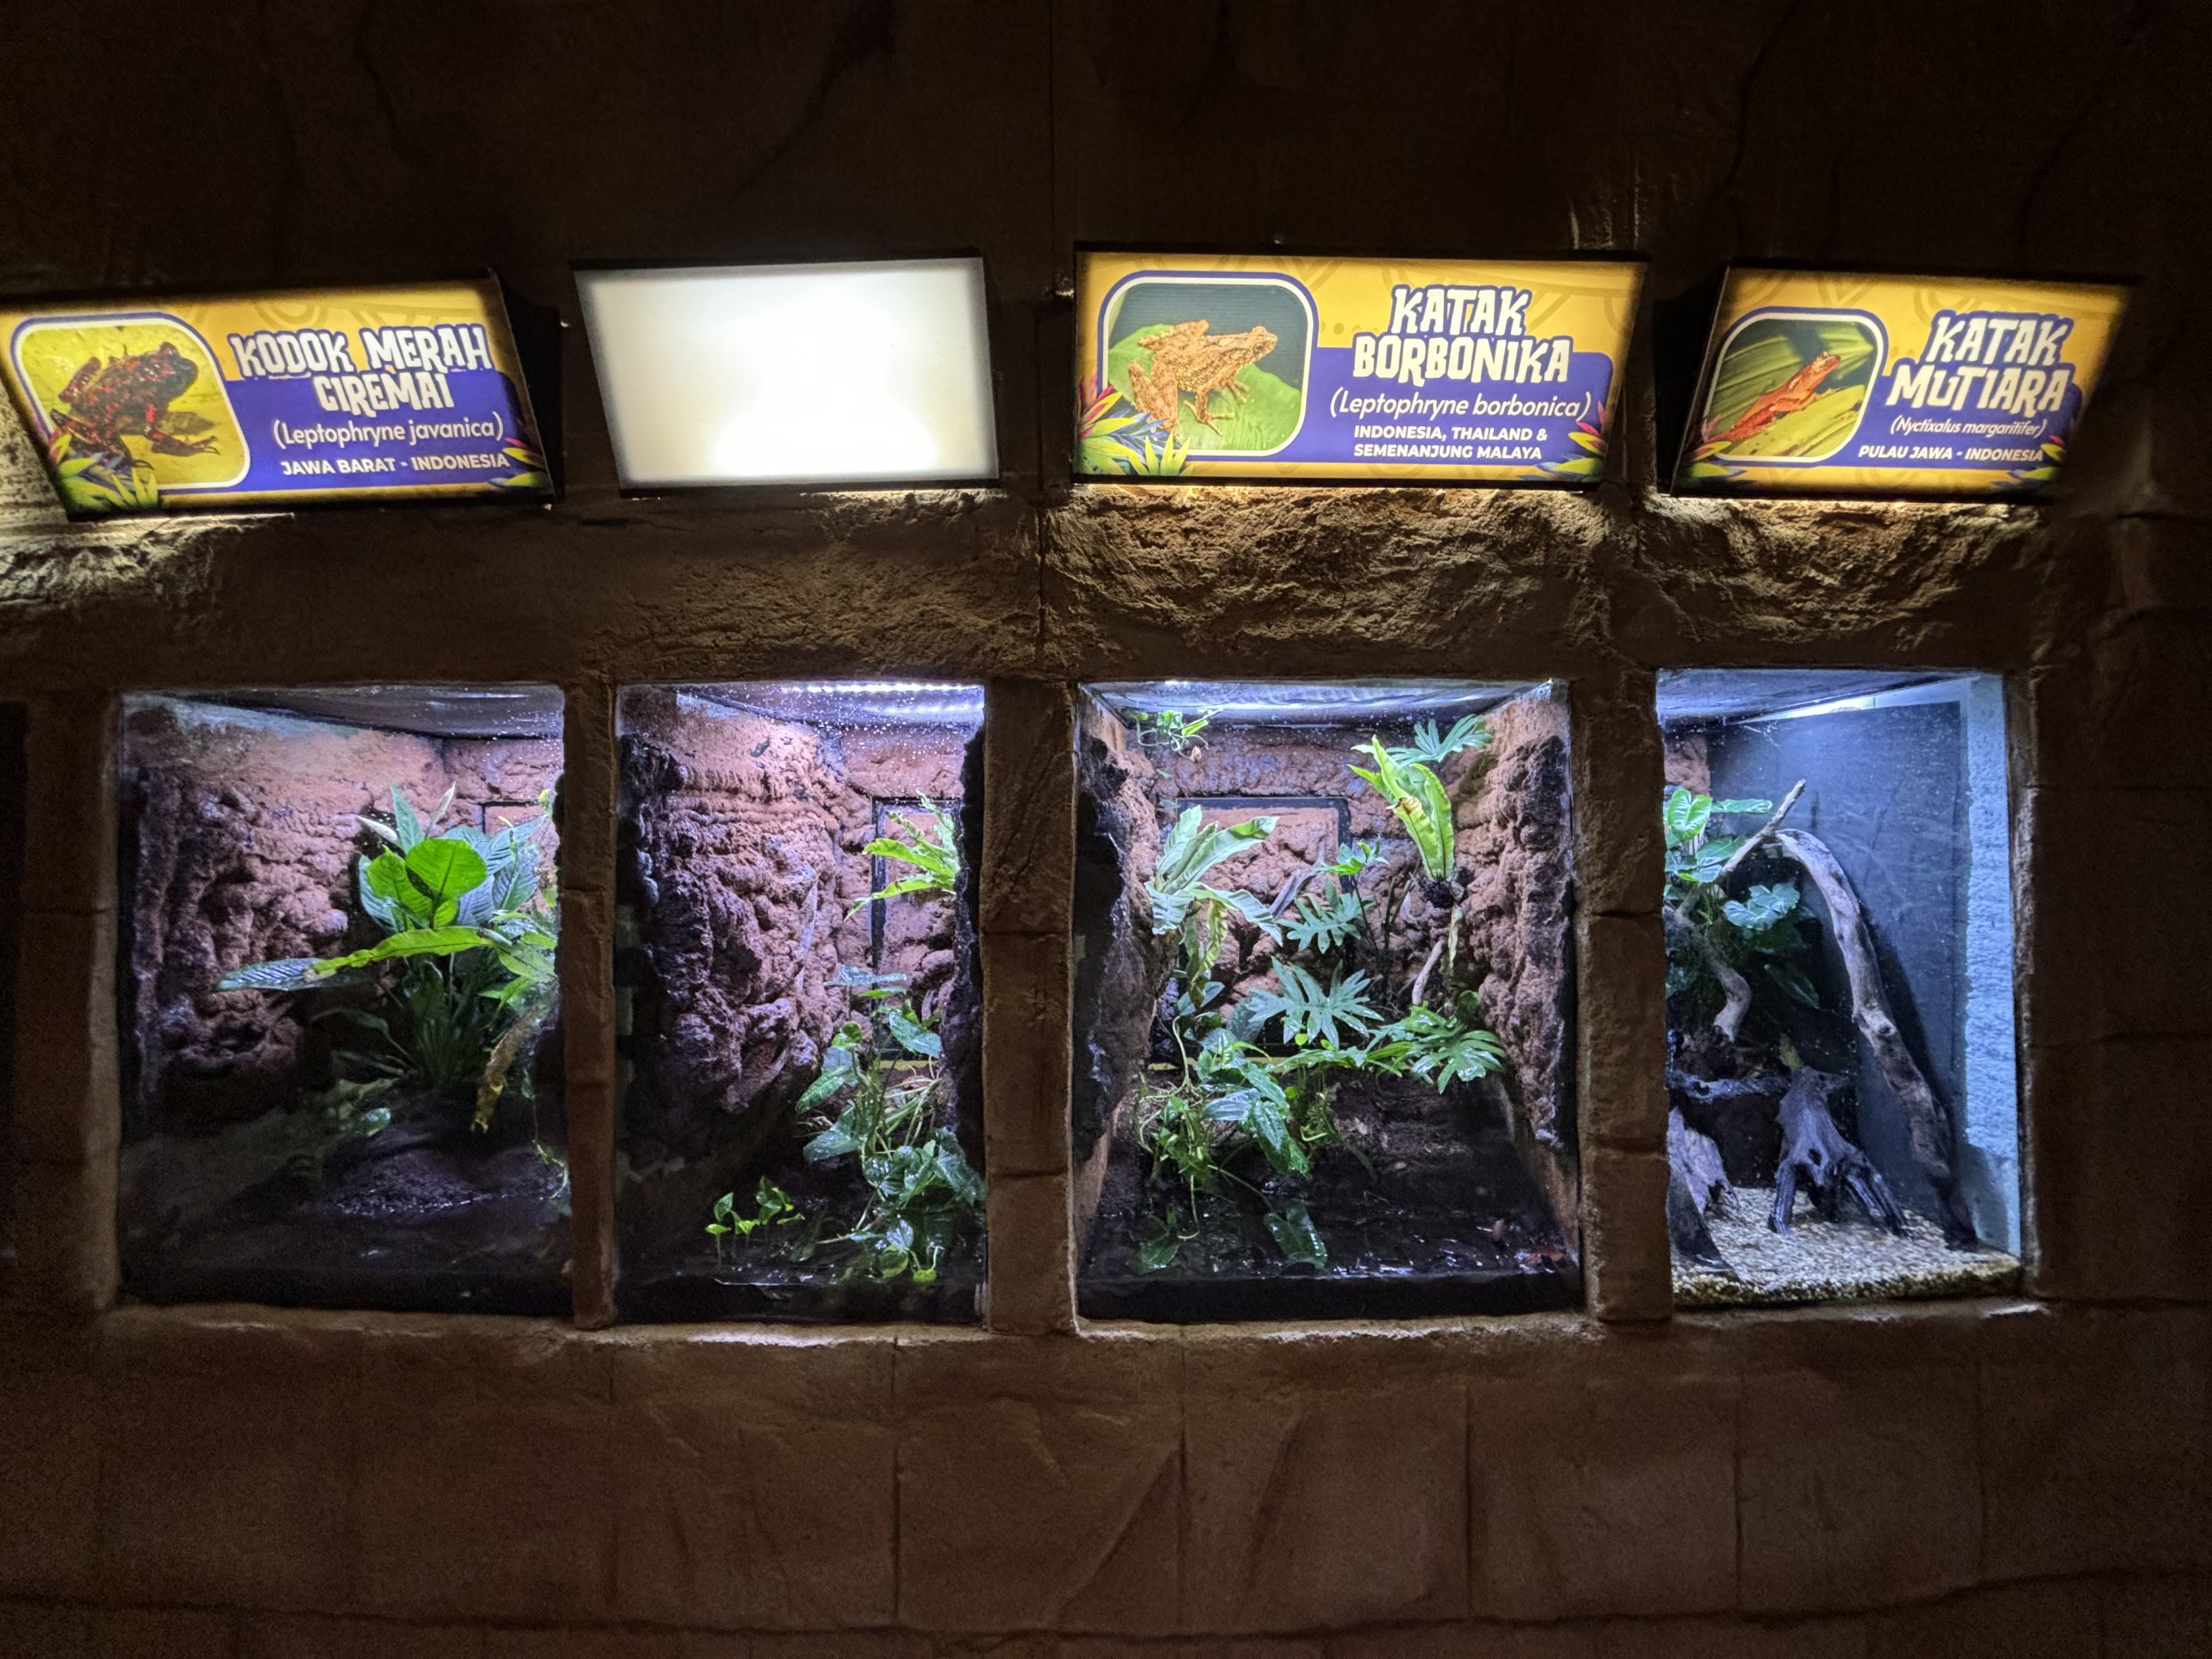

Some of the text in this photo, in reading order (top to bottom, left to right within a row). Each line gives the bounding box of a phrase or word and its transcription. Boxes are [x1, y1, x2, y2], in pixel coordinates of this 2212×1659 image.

[1391, 288, 1528, 335] KATAK
[230, 326, 492, 376] KODOK MERAH
[1927, 316, 2068, 366] KATAK
[1353, 335, 1570, 387] BORBONIKA
[313, 373, 455, 416] CIREMAI
[1330, 387, 1591, 420] (Leptophryne borbonica)
[1886, 364, 2071, 418] MUTIARA
[273, 412, 503, 449] (Leptophryne javanica)
[1354, 425, 1548, 442] INDONESIA, THAILAND &
[1890, 415, 1961, 435] (Nyctixalus
[281, 460, 333, 475] JAWA
[338, 459, 395, 474] BARAT
[412, 452, 510, 471] INDONESIA
[1353, 443, 1542, 460] SEMENANJUNG MALAYA
[1858, 445, 1907, 459] PULAU
[1909, 447, 1952, 460] JAWA
[1965, 448, 2044, 462] INDONESIA
